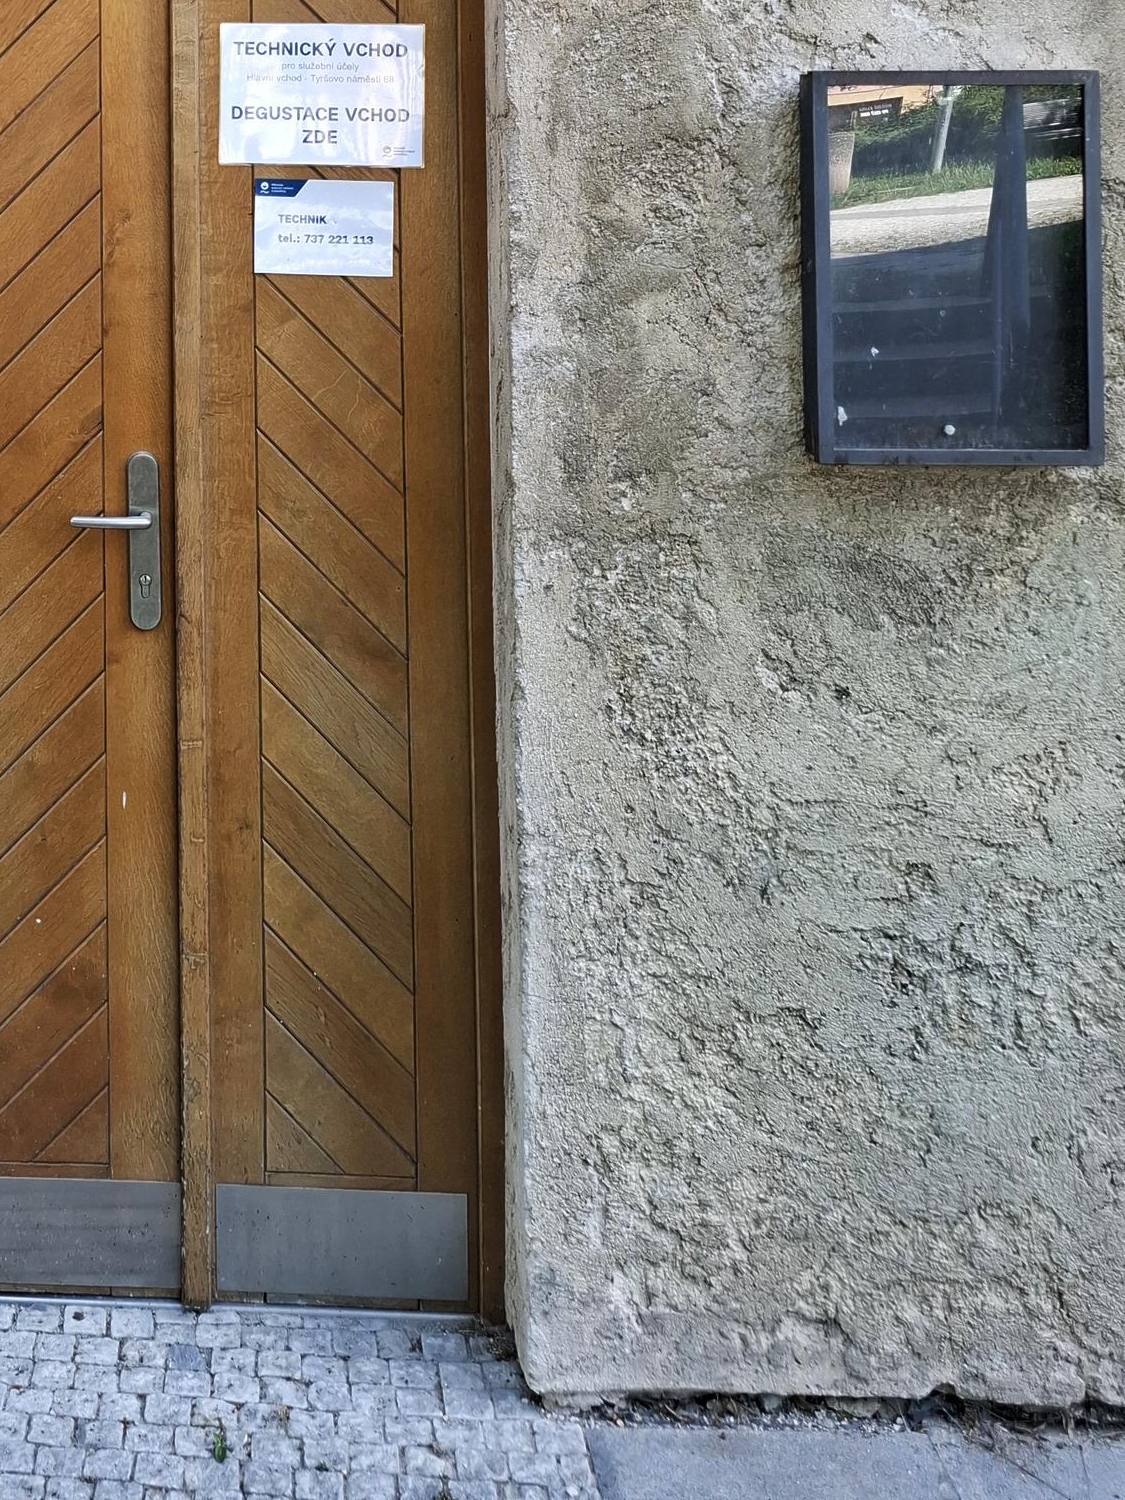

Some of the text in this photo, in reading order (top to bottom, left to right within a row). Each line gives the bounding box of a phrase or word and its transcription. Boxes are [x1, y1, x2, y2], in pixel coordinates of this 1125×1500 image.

[233, 38, 409, 58] TECHNICKÝ VCHOD
[281, 62, 360, 73] pro služební účely
[276, 74, 302, 83] vchod
[310, 74, 344, 85] Tyršovo
[231, 106, 411, 122] DEGUSTACE VCHOD
[302, 129, 338, 144] ZDE
[277, 214, 327, 225] TECHNIK
[277, 233, 374, 245] tel.: 737 221 113
